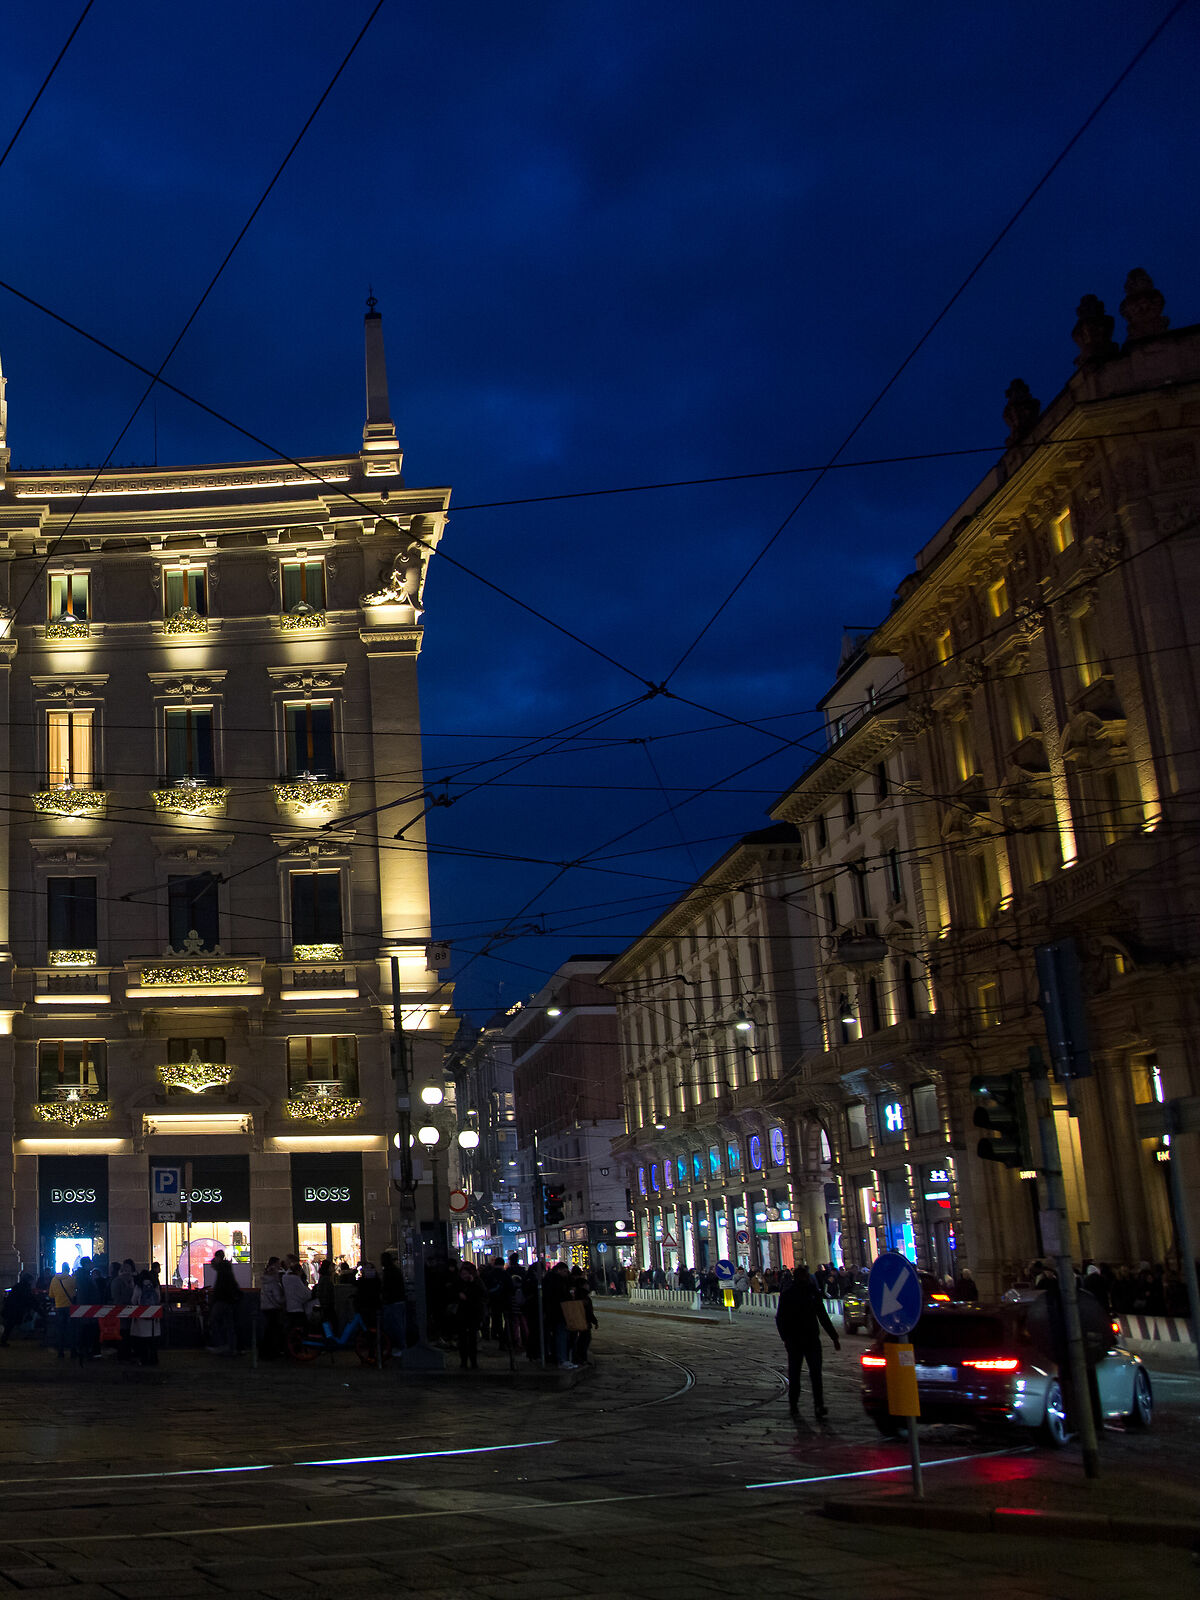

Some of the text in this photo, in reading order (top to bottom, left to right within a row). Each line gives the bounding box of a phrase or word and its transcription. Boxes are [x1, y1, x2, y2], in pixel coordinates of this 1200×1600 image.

[160, 1172, 174, 1191] P
[51, 1188, 96, 1203] BOSS
[180, 1188, 223, 1204] BOSS
[304, 1187, 351, 1202] BOSS
